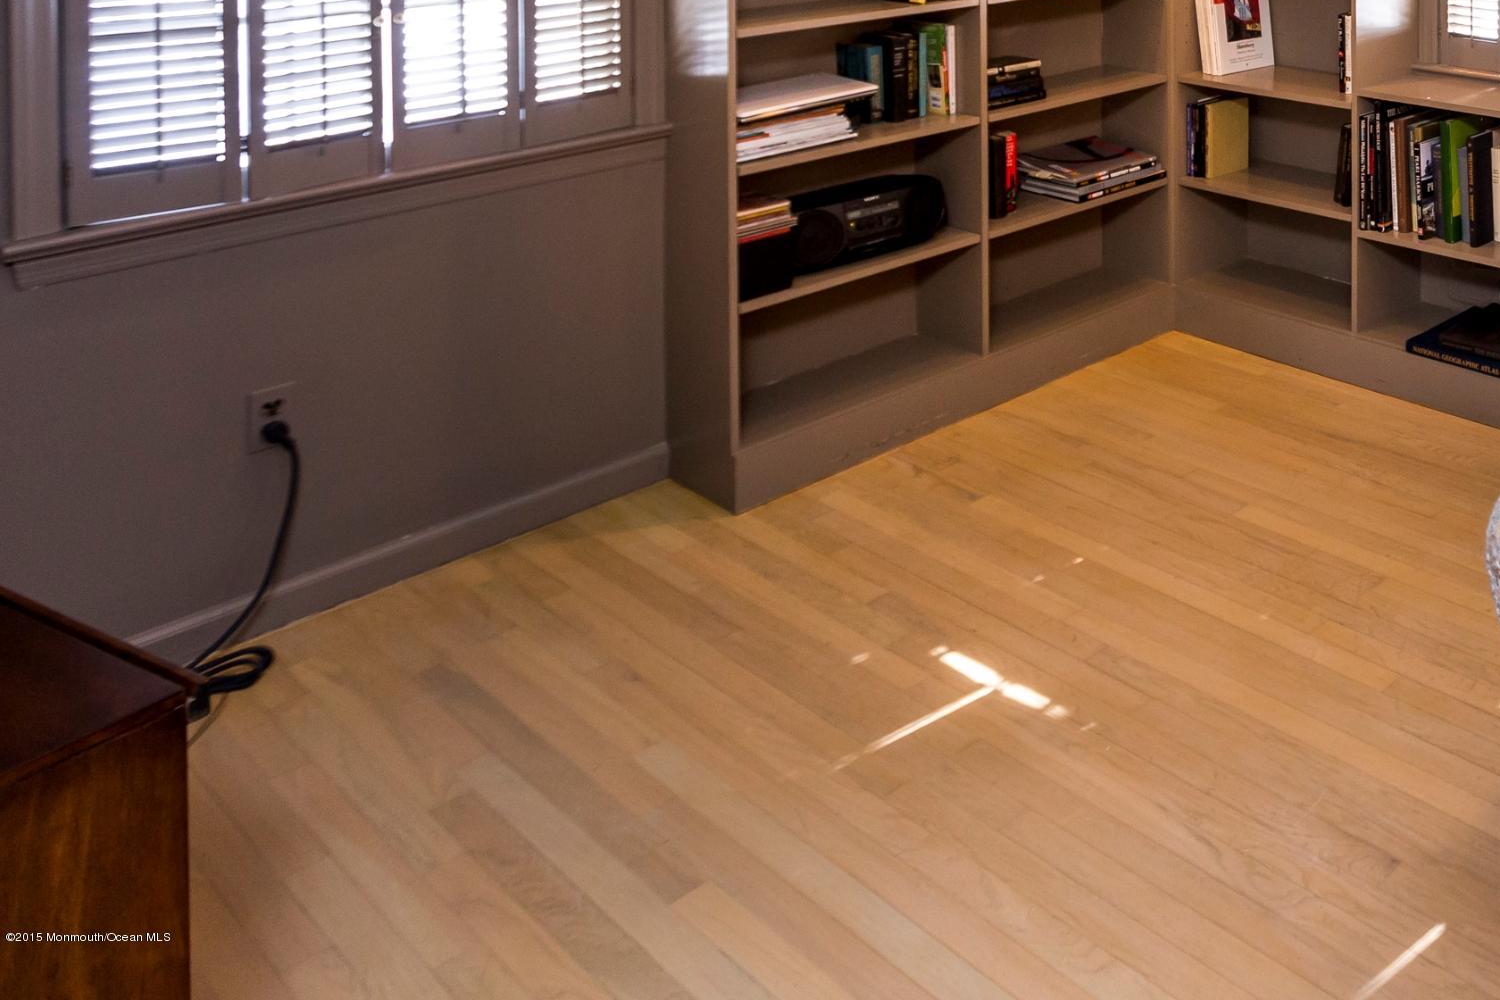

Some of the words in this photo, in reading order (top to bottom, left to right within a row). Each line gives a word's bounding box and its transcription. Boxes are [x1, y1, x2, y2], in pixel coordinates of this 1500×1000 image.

[1412, 345, 1440, 359] NATIONAL
[1441, 353, 1480, 370] GEOGRAPHIC
[1480, 365, 1500, 376] ATLAS
